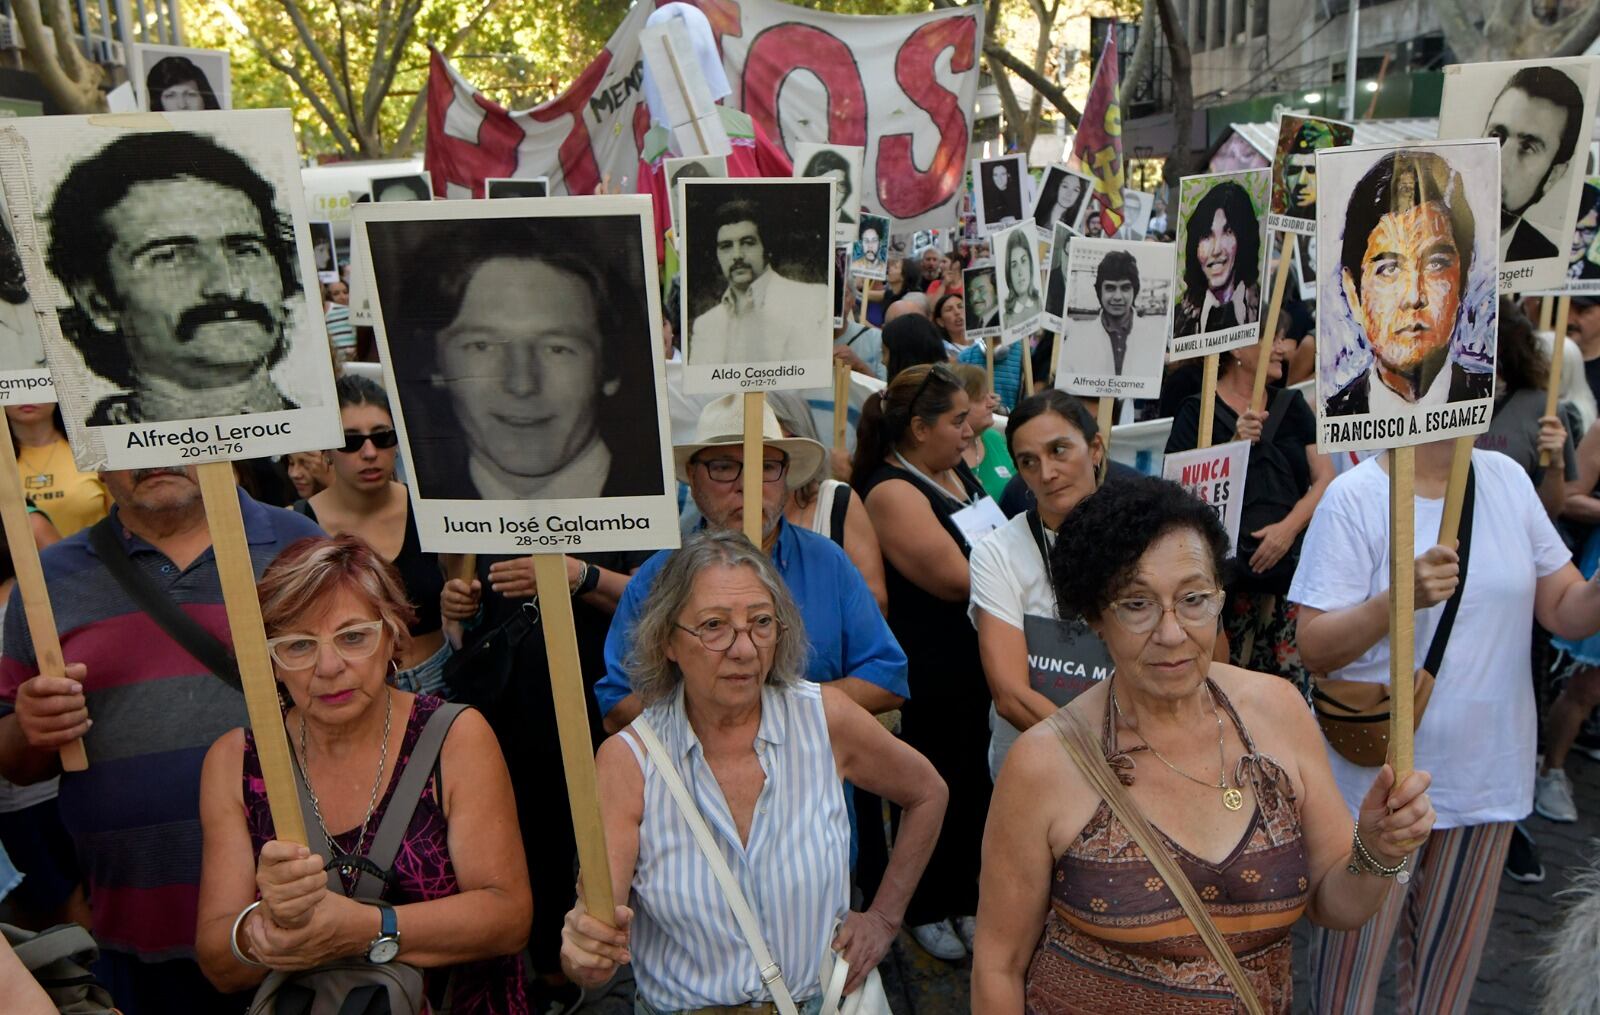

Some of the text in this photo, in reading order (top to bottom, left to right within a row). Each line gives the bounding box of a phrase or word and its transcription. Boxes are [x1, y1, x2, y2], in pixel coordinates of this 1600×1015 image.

[1281, 218, 1305, 230] ISIDRO
[1174, 342, 1198, 353] MANUEL
[1205, 335, 1228, 347] TAMAYO
[1229, 328, 1256, 342] MARTINEZ
[711, 365, 805, 380] Aldo Casadidio
[740, 378, 777, 387] 07-12-76
[1073, 377, 1145, 389] Alfredo Escamez
[1323, 404, 1488, 444] FRANCISCO A. ESCAMEZ
[127, 422, 291, 449] Alfredo Lerouc
[180, 442, 243, 458] 20-11-76
[1181, 456, 1230, 487] NUNCA
[1213, 480, 1230, 503] ES
[444, 513, 650, 534] Juan José Galamba
[514, 534, 582, 546] 28-05-78
[1027, 653, 1116, 681] NUNCA M
